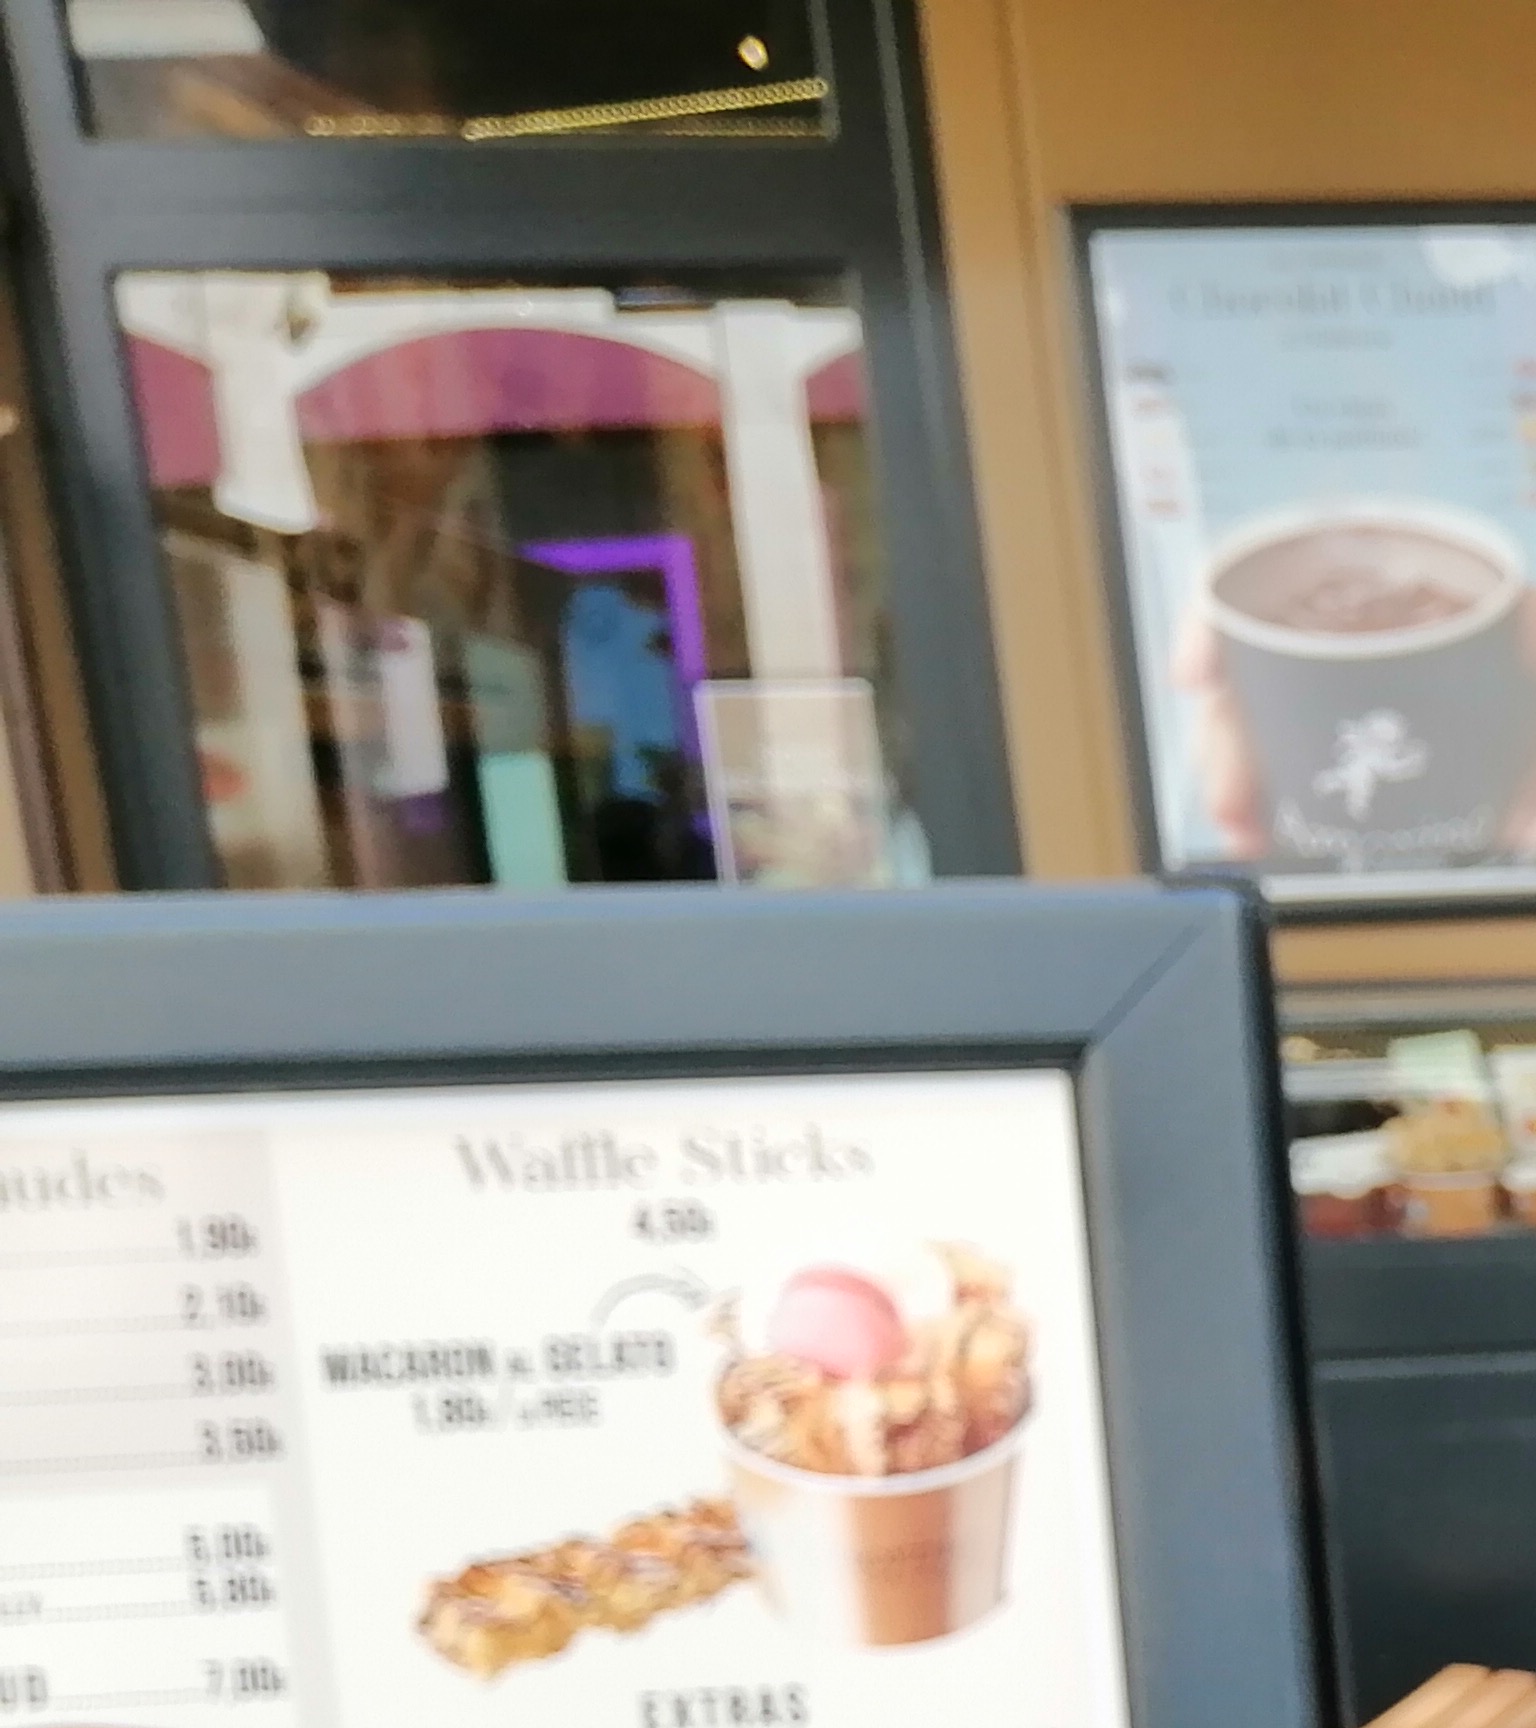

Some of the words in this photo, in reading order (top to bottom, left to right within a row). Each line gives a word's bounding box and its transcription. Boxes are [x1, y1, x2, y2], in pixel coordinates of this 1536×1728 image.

[0, 1148, 166, 1212] udes
[453, 1130, 661, 1190] Waffle
[678, 1121, 877, 1184] Sticks
